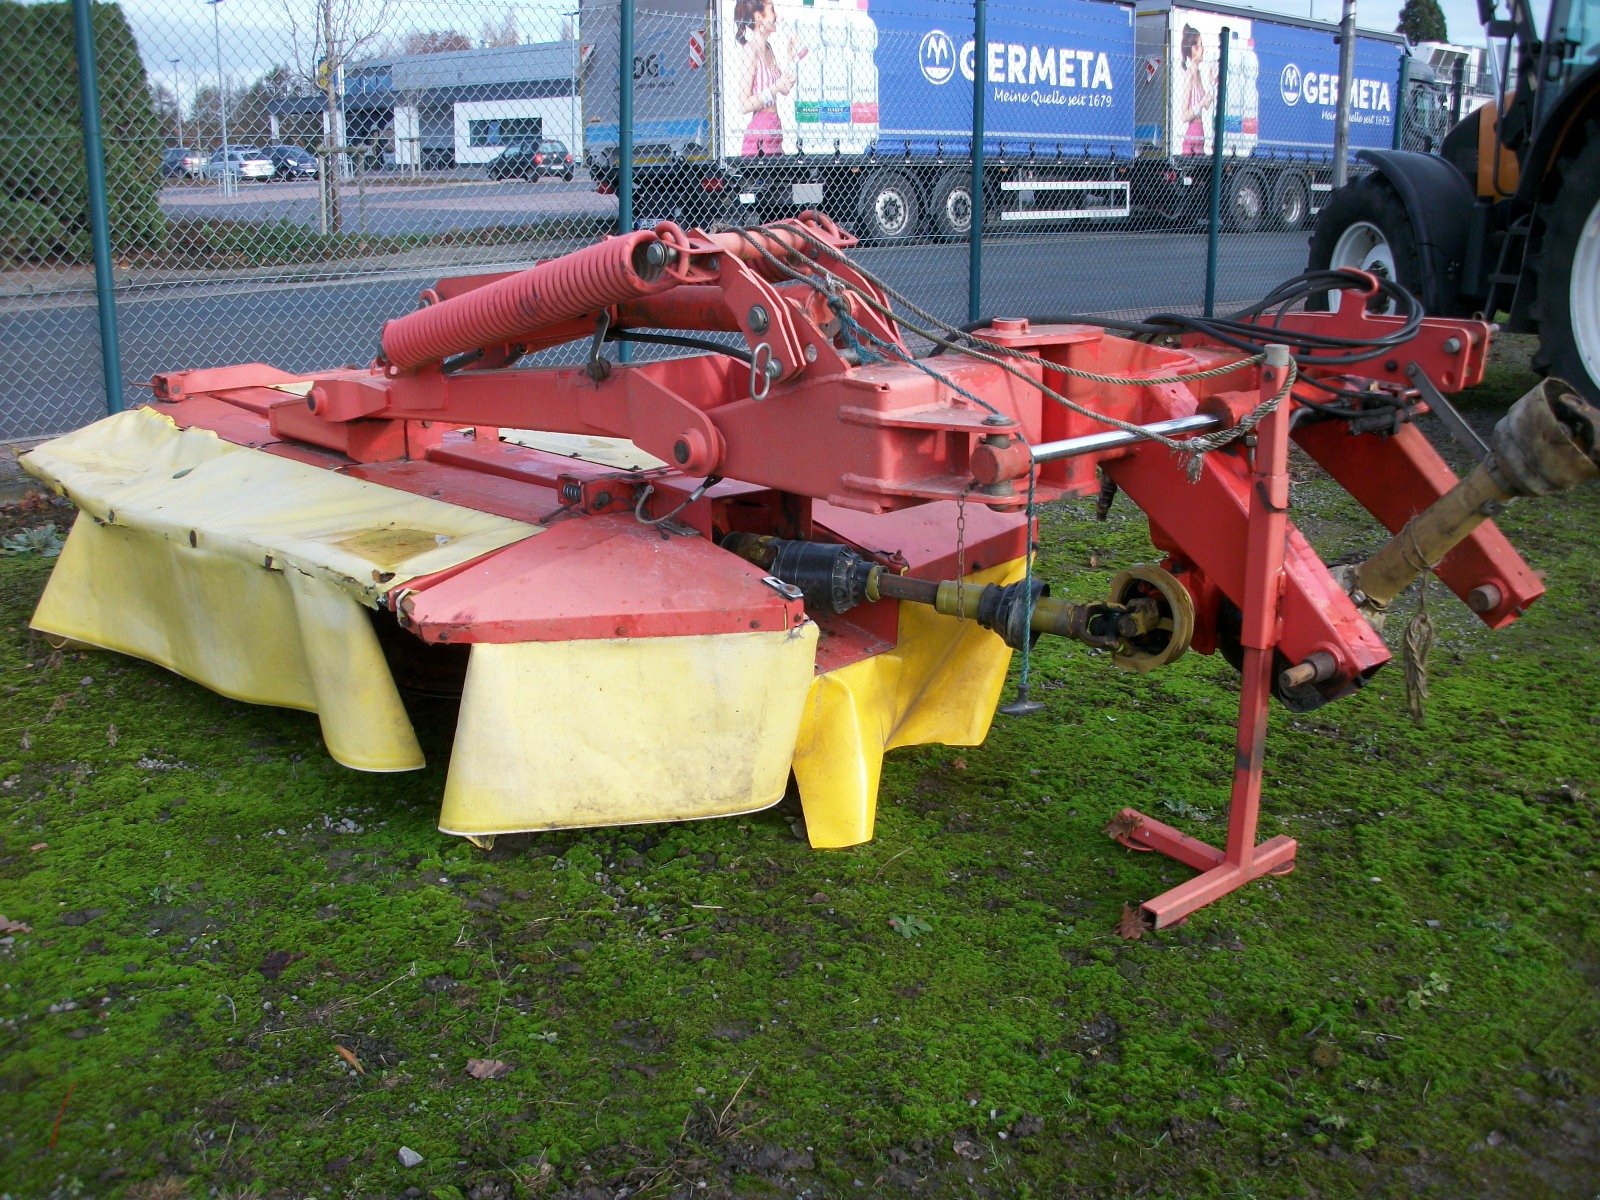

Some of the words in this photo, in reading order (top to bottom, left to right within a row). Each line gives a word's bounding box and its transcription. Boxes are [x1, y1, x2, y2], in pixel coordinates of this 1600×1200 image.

[959, 40, 1113, 90] GERMETA
[994, 87, 1030, 103] Meine
[1031, 90, 1066, 107] Quelle
[1067, 94, 1087, 106] seit
